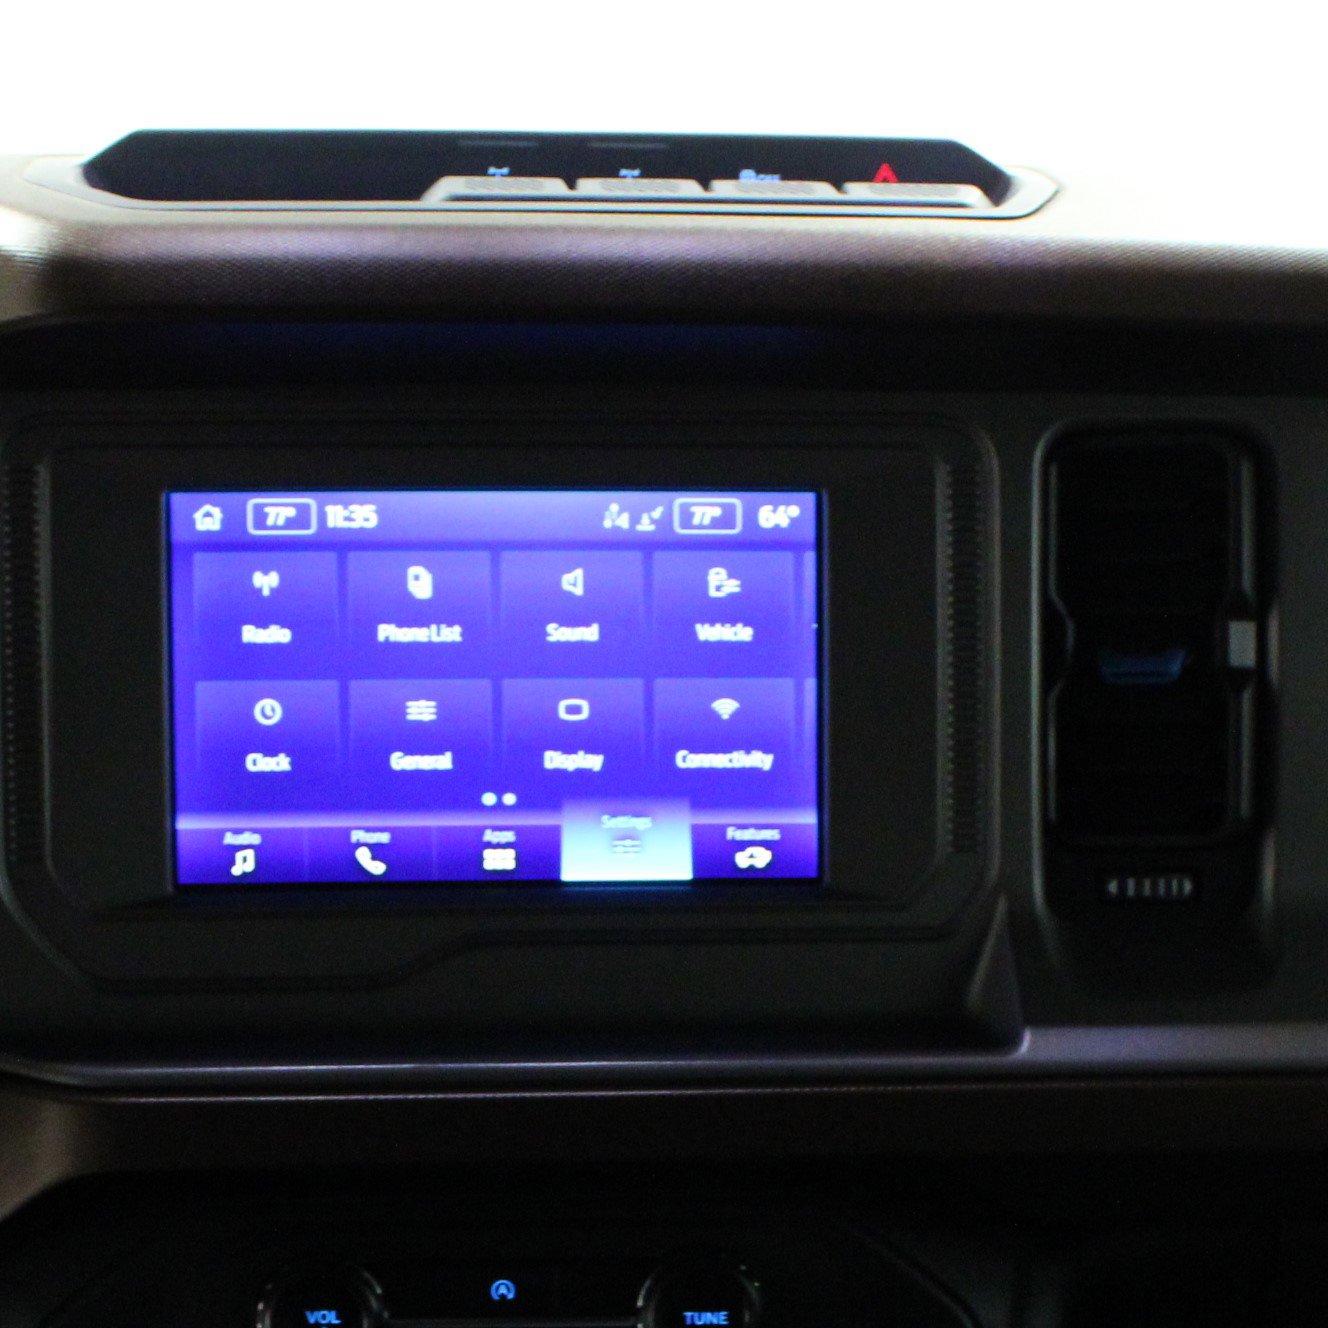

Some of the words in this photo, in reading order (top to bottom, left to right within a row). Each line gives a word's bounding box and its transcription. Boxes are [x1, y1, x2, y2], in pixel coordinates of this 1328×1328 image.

[324, 504, 379, 528] 11:35
[757, 504, 800, 528] 64°
[241, 624, 292, 643] Radio
[377, 623, 429, 642] Phone
[430, 623, 462, 642] List
[545, 622, 600, 641] Sound
[694, 622, 754, 641] Vehicle
[245, 753, 292, 772] Clock
[389, 751, 453, 770] General
[543, 750, 604, 772] Display
[675, 750, 774, 771] Connectivity
[601, 815, 653, 830] Settings
[223, 831, 262, 845] Audio
[350, 829, 391, 844] Phone
[483, 829, 516, 844] Apps
[726, 826, 781, 841] Features
[305, 1310, 341, 1325] VOL
[683, 1310, 730, 1326] TUNE
